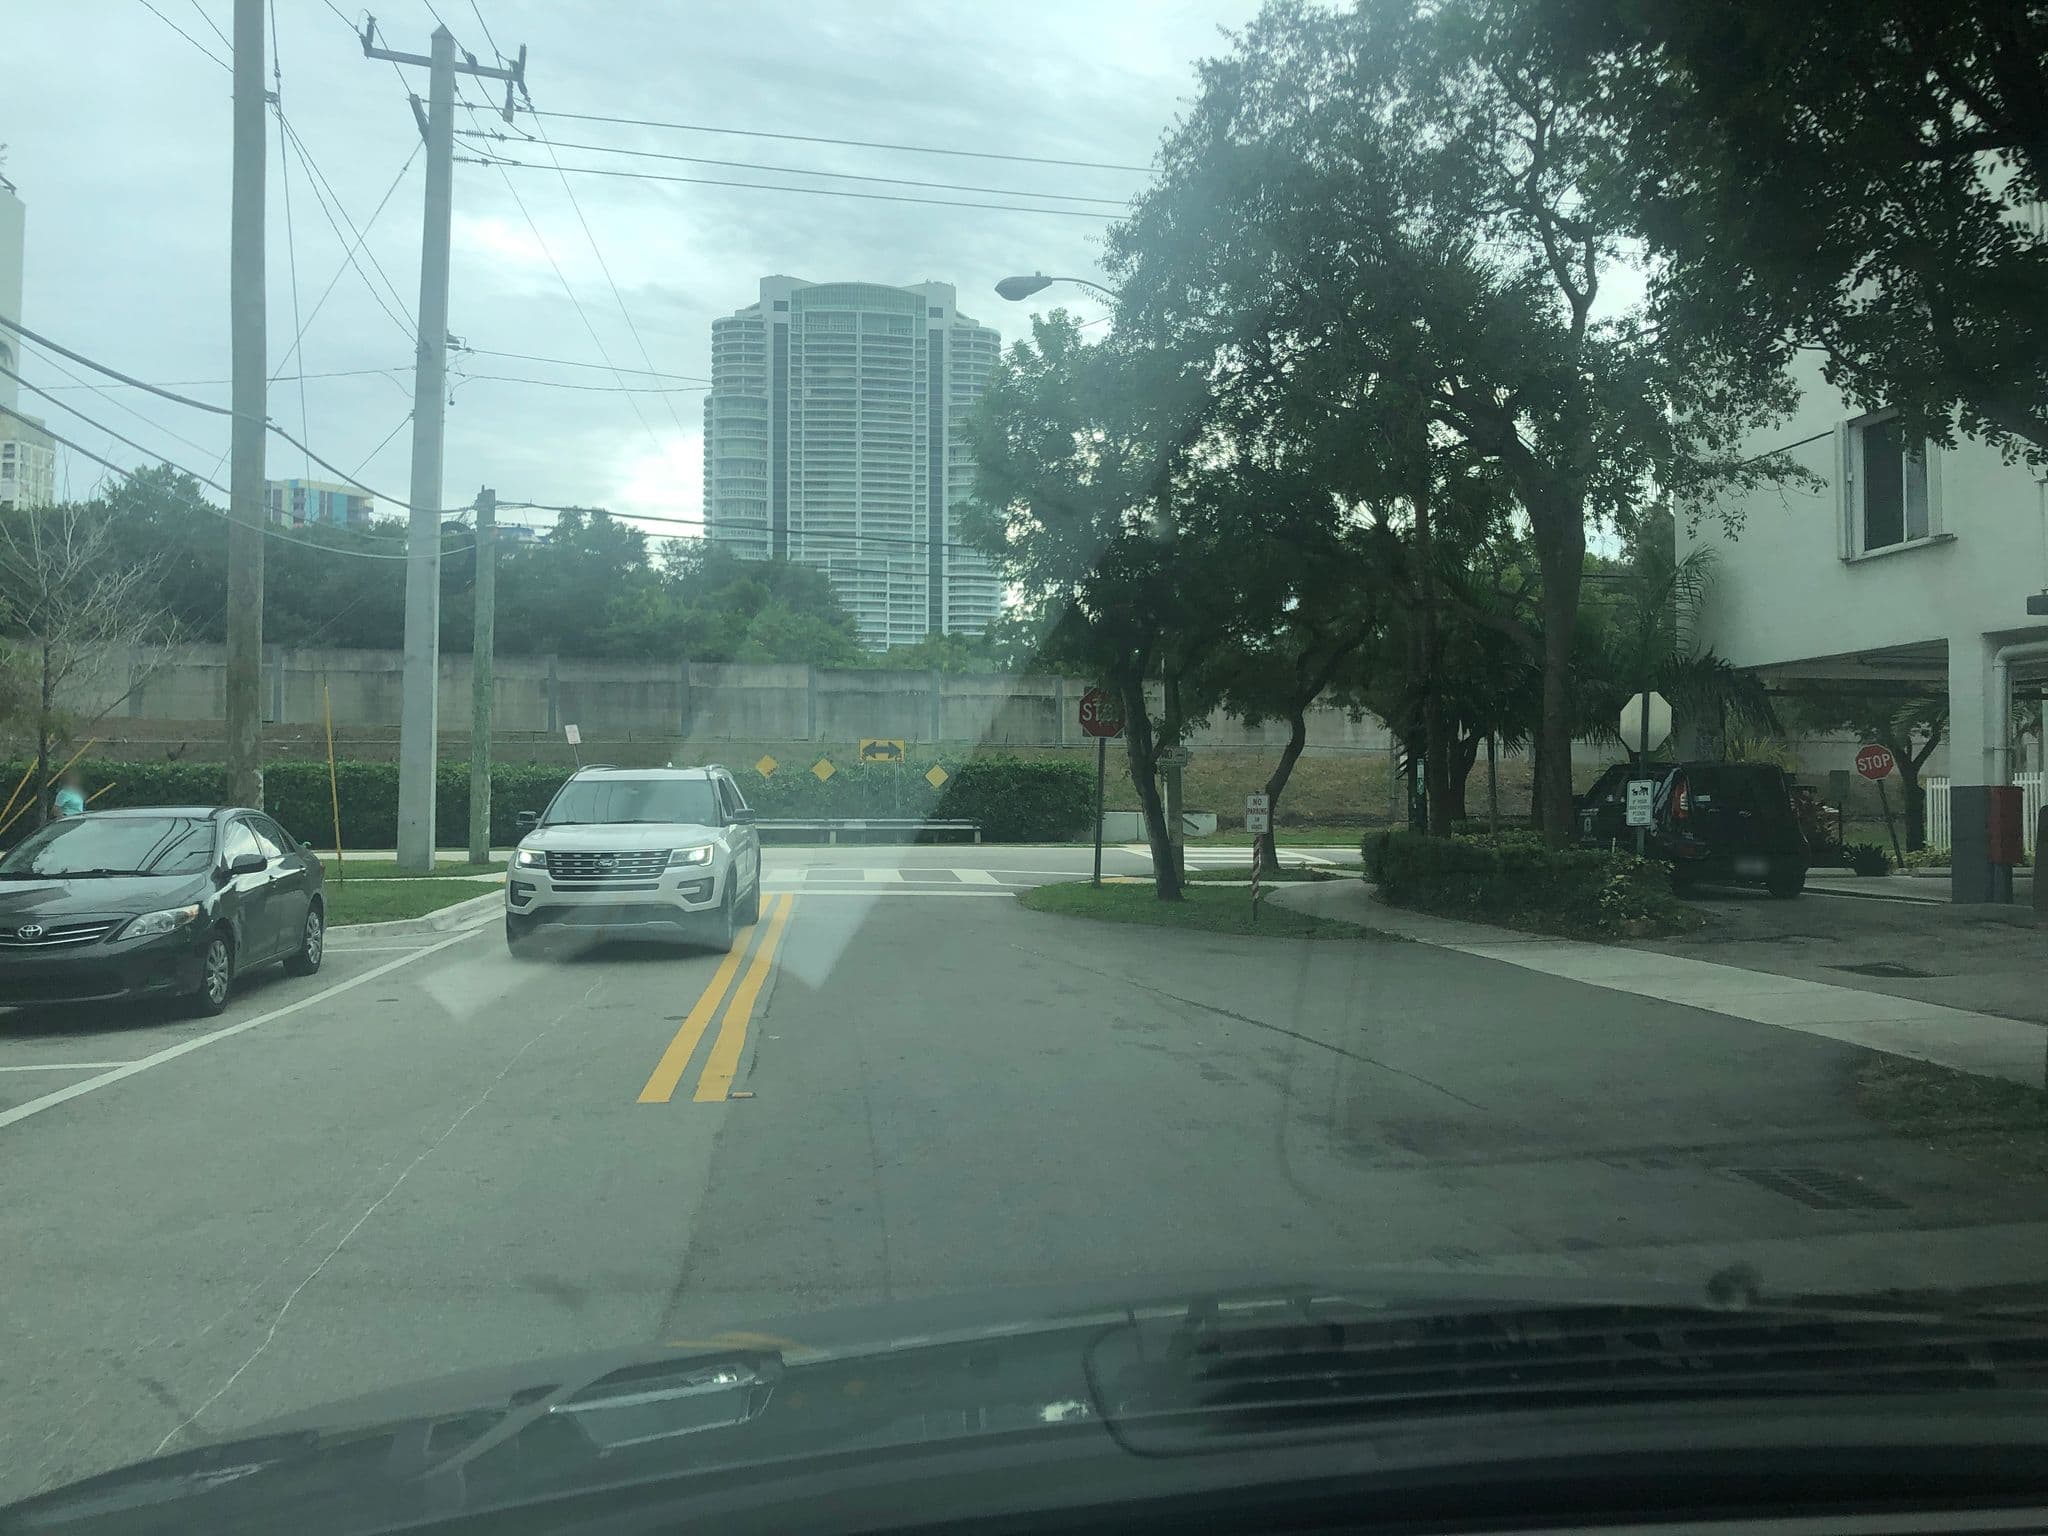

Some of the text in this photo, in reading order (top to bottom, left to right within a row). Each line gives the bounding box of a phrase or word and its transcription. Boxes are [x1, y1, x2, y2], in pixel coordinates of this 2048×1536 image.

[1082, 703, 1118, 721] STO
[1858, 753, 1890, 771] STOP
[1252, 798, 1263, 806] NO
[1247, 807, 1268, 816] PARKING
